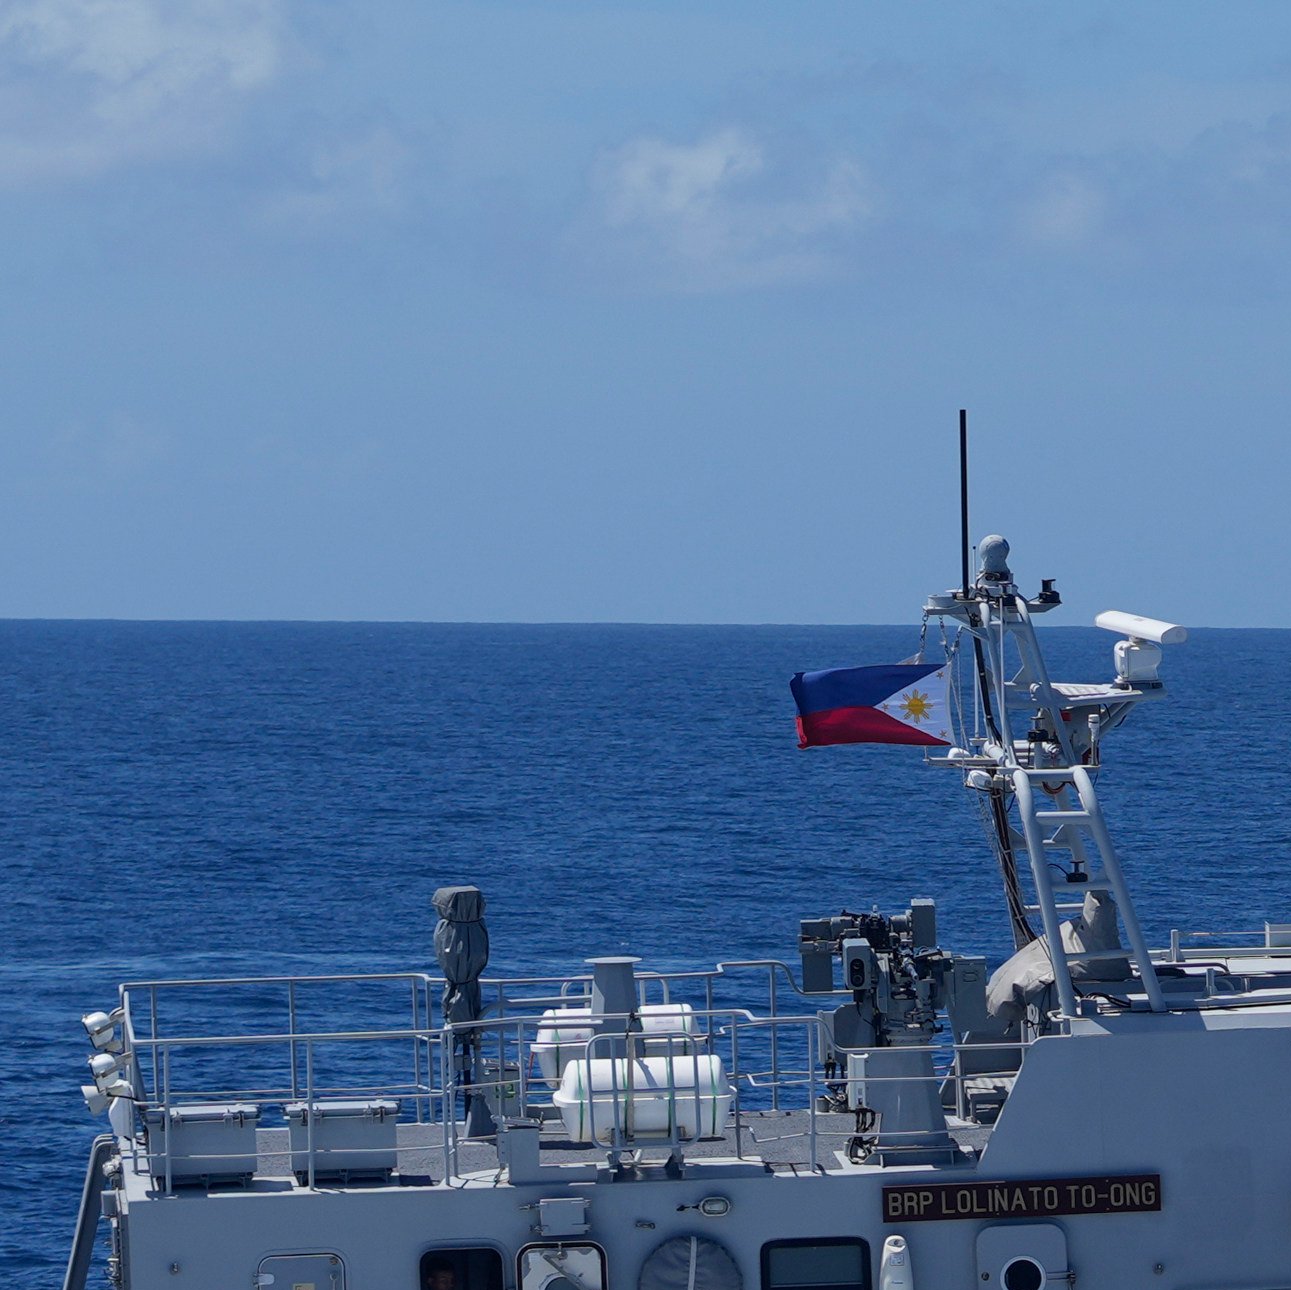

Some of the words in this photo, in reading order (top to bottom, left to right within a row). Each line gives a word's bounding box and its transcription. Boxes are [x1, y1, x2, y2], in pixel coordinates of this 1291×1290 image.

[888, 1192, 933, 1216] BRP
[941, 1186, 1058, 1214] LOLINATO
[1066, 1182, 1156, 1210] TO-ONG
